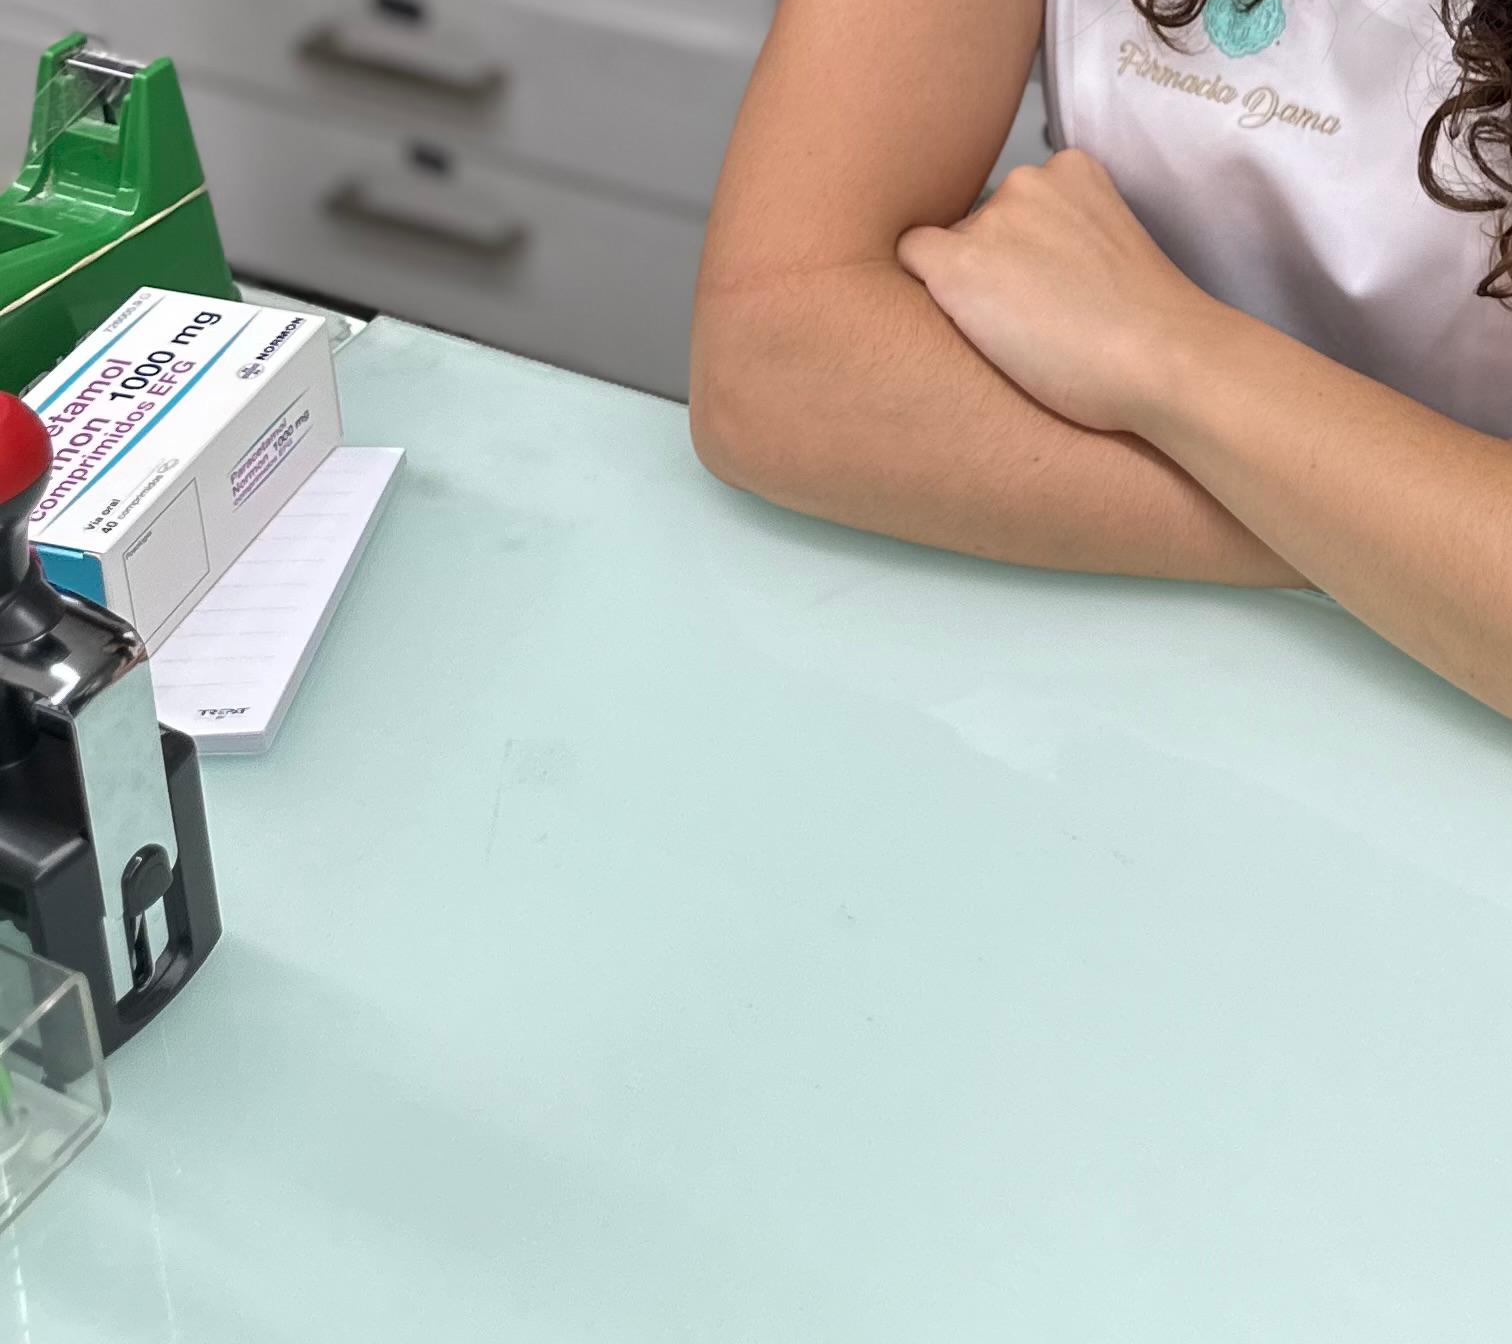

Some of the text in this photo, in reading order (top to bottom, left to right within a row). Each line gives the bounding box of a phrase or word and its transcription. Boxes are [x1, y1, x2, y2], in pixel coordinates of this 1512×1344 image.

[1118, 39, 1342, 136] Farmacia Dama
[256, 317, 305, 361] NORMON
[47, 358, 134, 438] etamol
[54, 310, 223, 470] mon 1000 mg
[147, 360, 197, 397] EFG
[230, 417, 287, 485] Paracetamol
[102, 521, 119, 534] 40
